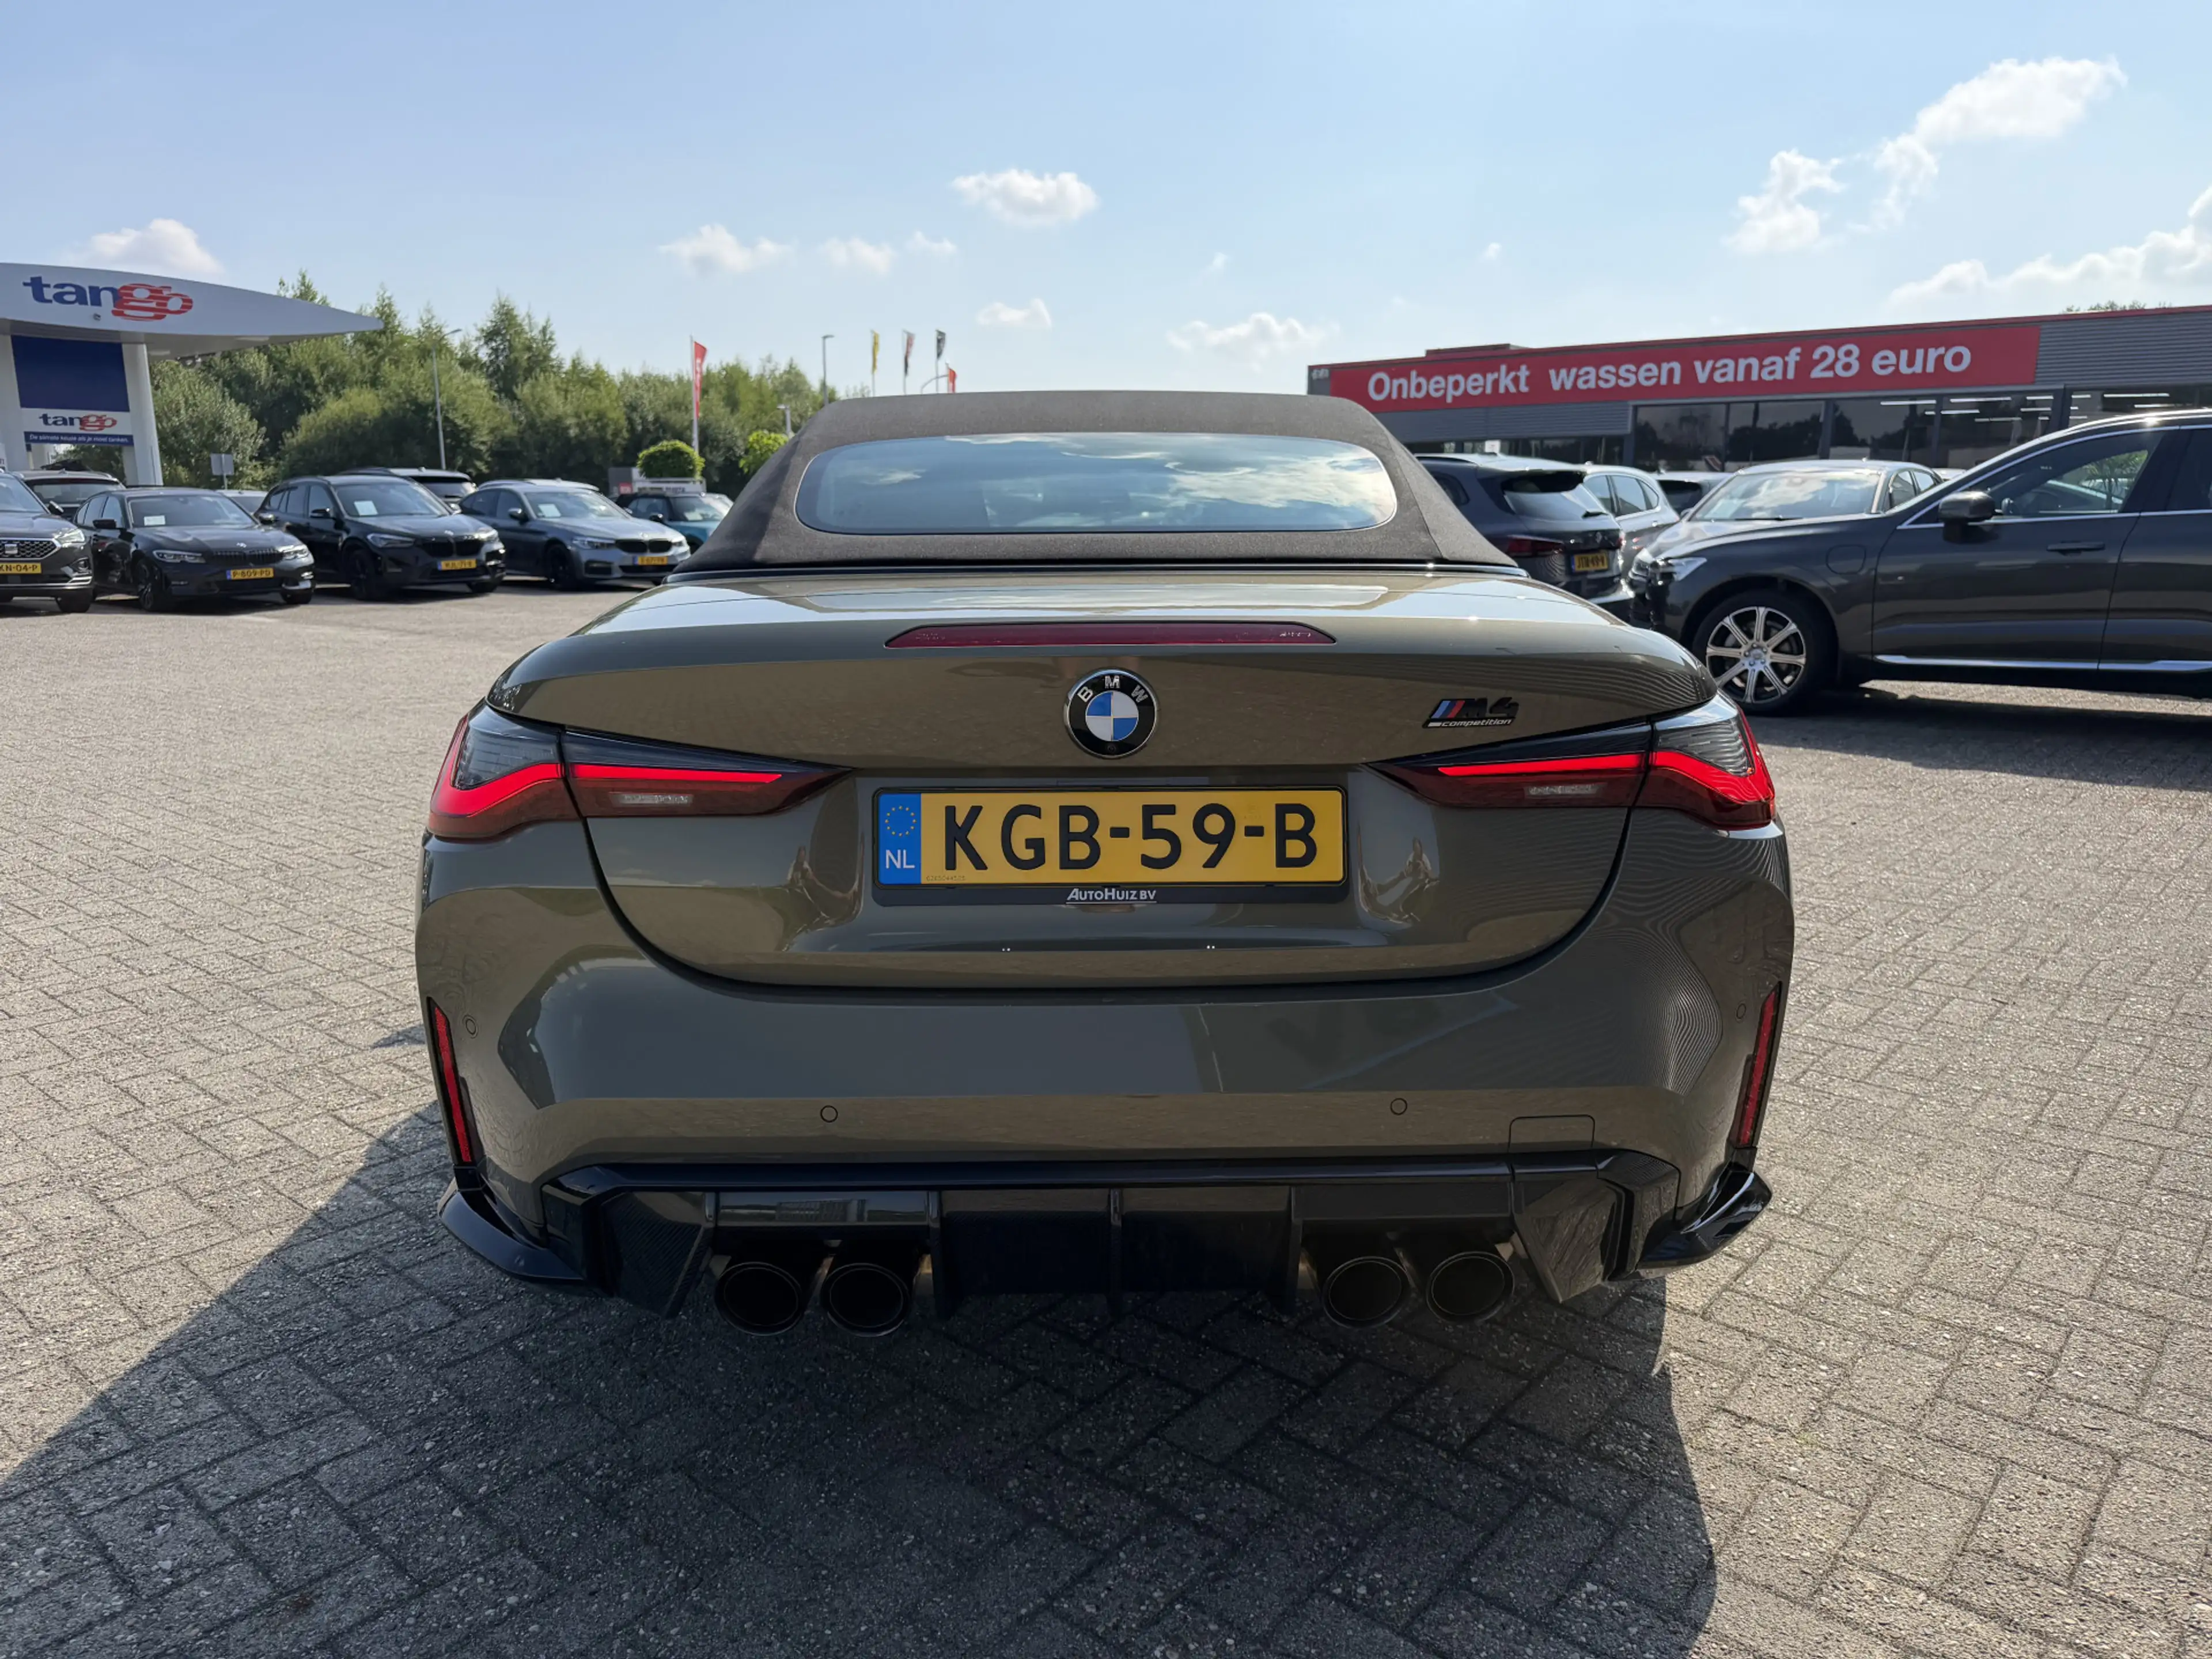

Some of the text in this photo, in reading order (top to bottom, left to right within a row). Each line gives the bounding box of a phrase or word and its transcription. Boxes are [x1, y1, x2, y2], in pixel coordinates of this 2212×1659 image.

[22, 276, 194, 321] tango
[1368, 344, 1972, 403] Onbeperkt wassen vanaf 28 euro
[39, 412, 118, 432] tango
[1077, 675, 1148, 702] BMW
[1441, 718, 1512, 727] competition
[945, 803, 1318, 870] KGB-59-B
[885, 850, 915, 869] NL
[1139, 890, 1157, 900] BV
